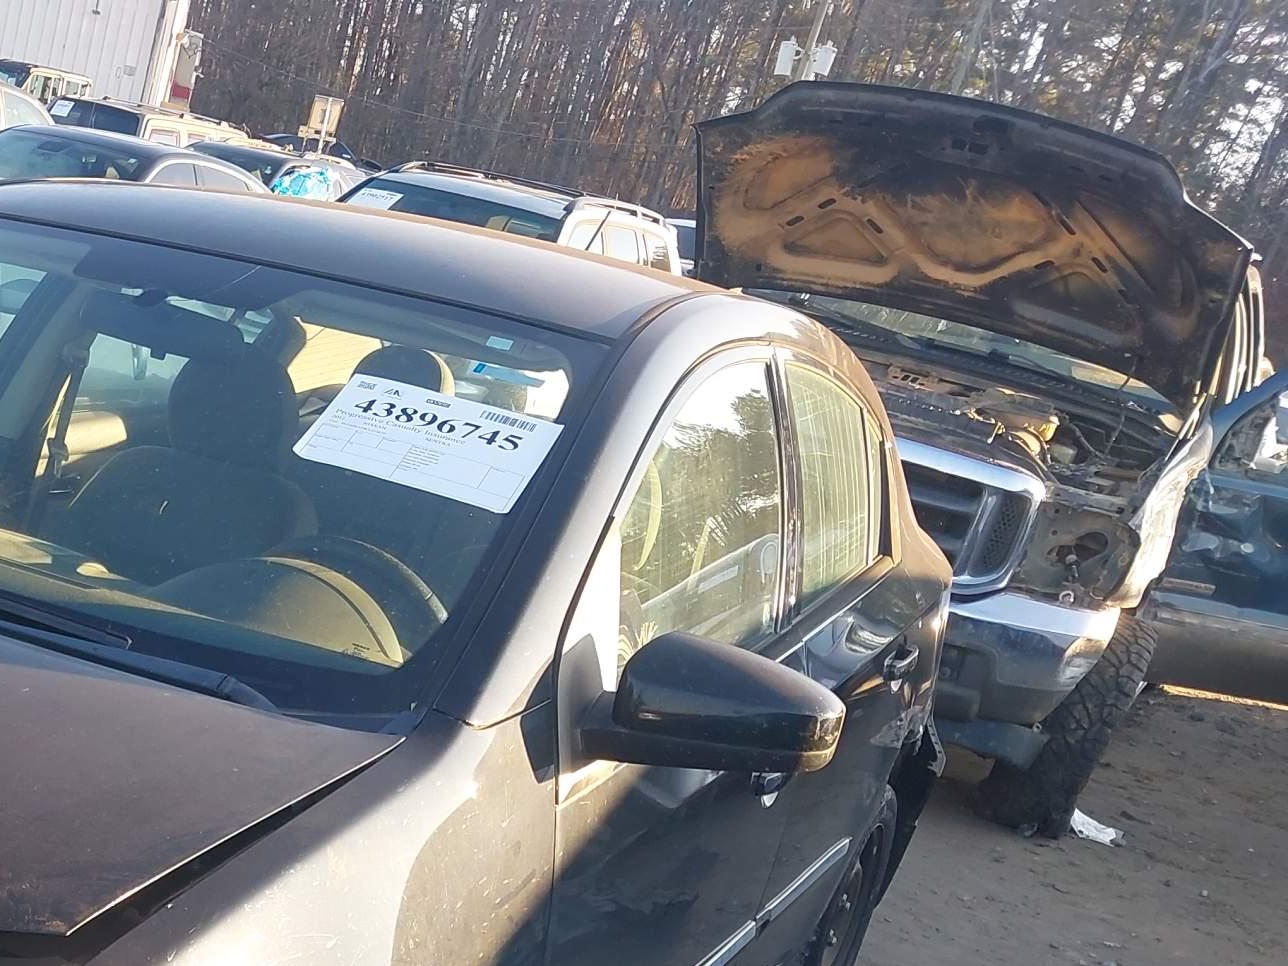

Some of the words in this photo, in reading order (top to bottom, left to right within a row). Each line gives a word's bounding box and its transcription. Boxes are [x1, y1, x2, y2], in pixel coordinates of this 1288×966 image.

[354, 398, 523, 451] 43896745
[385, 419, 421, 434] Casualty
[424, 429, 466, 445] Insurance
